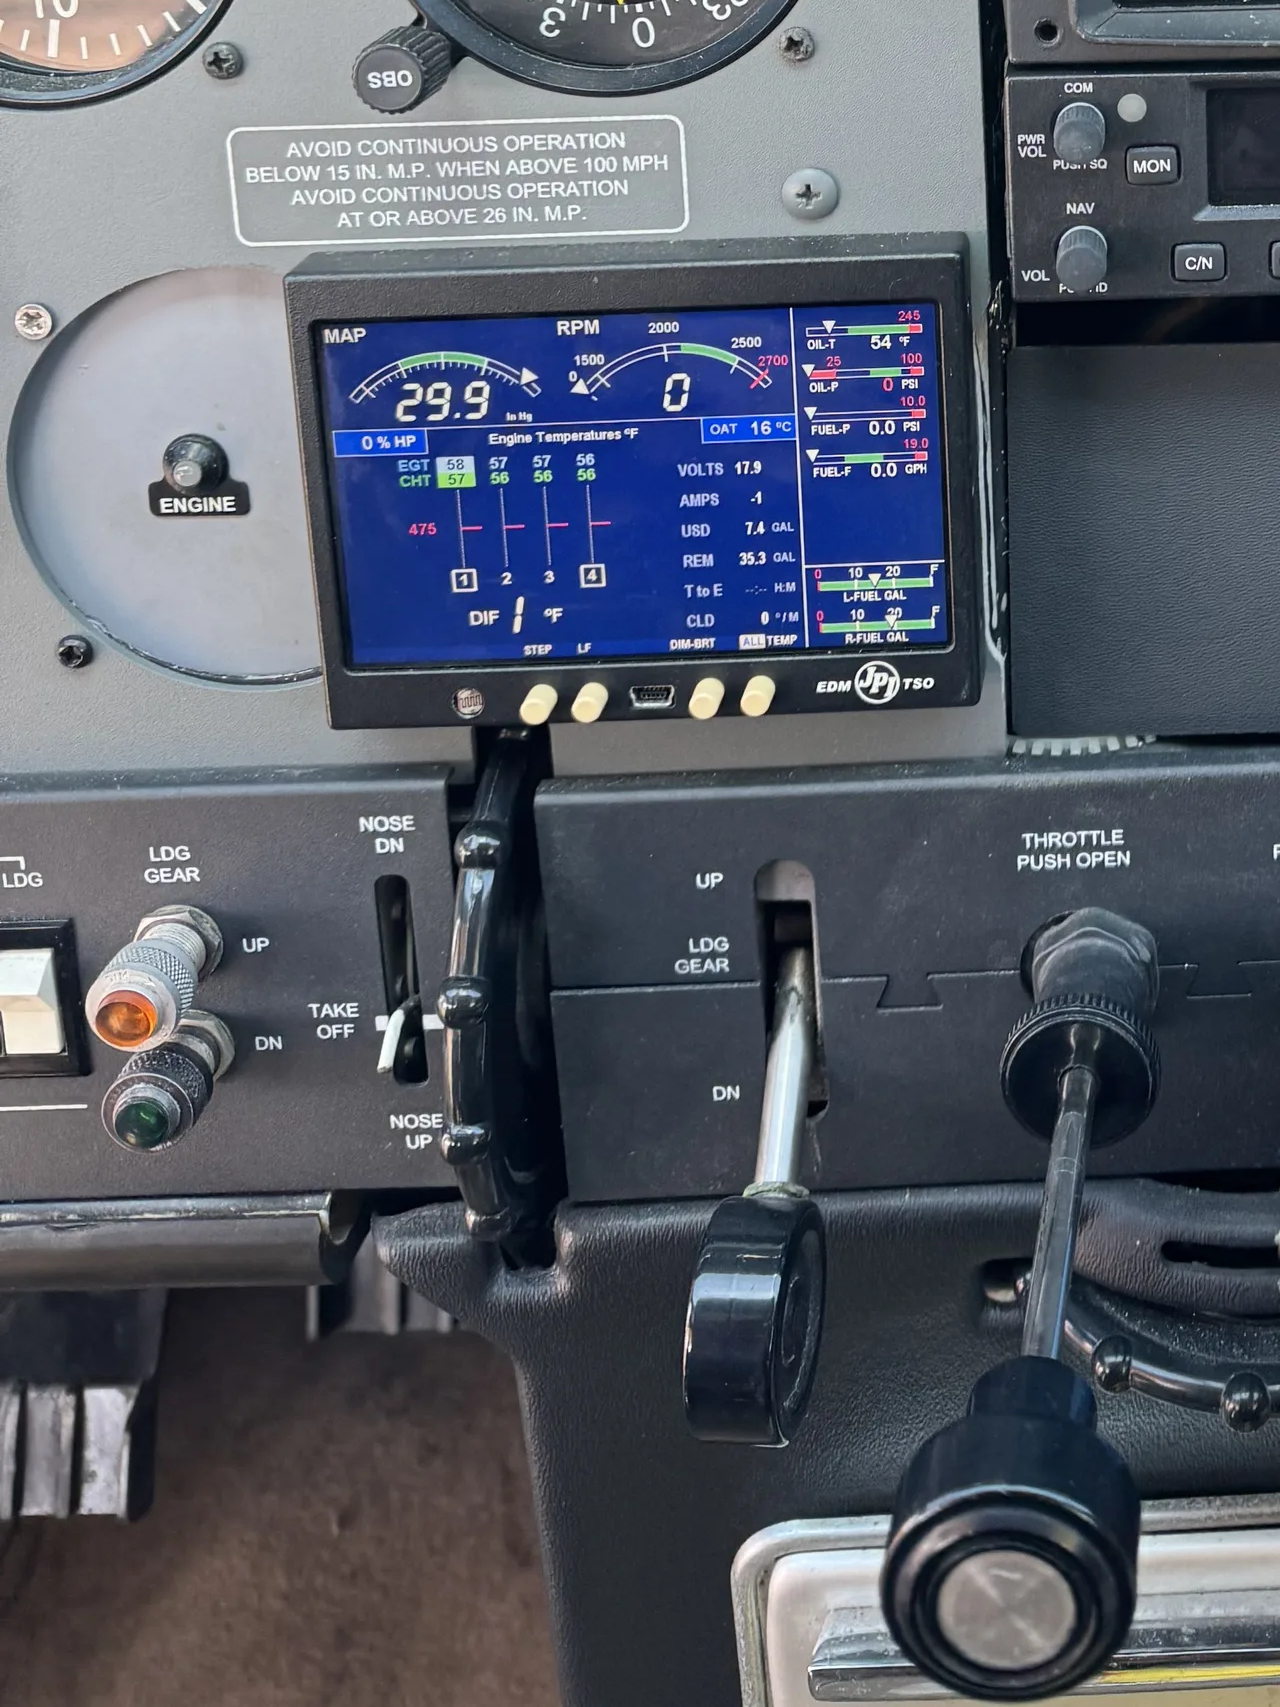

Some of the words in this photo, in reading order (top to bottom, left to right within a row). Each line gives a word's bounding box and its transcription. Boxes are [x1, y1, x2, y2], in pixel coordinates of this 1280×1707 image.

[366, 69, 413, 88] OBS
[1064, 82, 1093, 93] COM
[287, 140, 351, 158] AVOID
[357, 136, 497, 156] CONTINUOUS
[503, 132, 625, 152] OPERATION
[1018, 134, 1045, 145] PWR
[1018, 146, 1046, 158] VOL
[245, 165, 320, 183] BELOW
[326, 164, 349, 181] 15
[356, 163, 382, 180] IN.
[388, 162, 430, 179] M.P.
[437, 160, 500, 178] WHEN
[505, 158, 577, 176] ABOVE
[584, 156, 616, 174] 100
[623, 154, 668, 172] MPH
[1133, 159, 1171, 174] MON
[1066, 202, 1094, 214] NAV
[337, 211, 364, 229] AT
[369, 210, 401, 227] OR
[406, 208, 477, 225] ABOVE
[482, 206, 506, 224] 26
[512, 206, 538, 223] IN.
[544, 204, 587, 222] M.P.
[1185, 255, 1213, 270] C/N
[1021, 270, 1049, 282] VOL
[556, 320, 600, 336] RPM
[648, 322, 679, 333] 2000
[323, 328, 366, 344] MAP
[731, 337, 762, 348] 2500
[807, 339, 836, 350] OIL-T
[574, 354, 605, 366] 1500
[758, 355, 788, 367] 2700
[809, 381, 839, 393] OIL-P
[396, 381, 490, 423] 29.9
[710, 423, 738, 435] OAT
[811, 423, 850, 436] FUEL-P
[395, 434, 416, 448] HP
[488, 432, 533, 447] Engine
[536, 429, 621, 444] Temperatures
[398, 459, 429, 473] EGT
[677, 462, 723, 477] VOLTS
[734, 461, 762, 474] 17.9
[813, 465, 852, 478] FUEL-F
[905, 463, 927, 474] GPH
[399, 474, 431, 487] CHT
[159, 496, 236, 514] ENGINE
[679, 493, 719, 508] AMPS
[681, 524, 711, 537] USD
[745, 522, 765, 536] 7.4
[772, 522, 794, 533] GAL
[683, 554, 714, 567] REM
[739, 552, 766, 565] 35.3
[843, 590, 881, 602] L-FUEL
[468, 610, 500, 625] DIF
[687, 613, 715, 627] CLD
[670, 637, 716, 650] DIM-BRT
[742, 636, 764, 647] ALL
[767, 635, 798, 647] TEMP
[845, 632, 883, 644] R-FUEL
[524, 644, 552, 656] STEP
[816, 680, 851, 693] EDM
[903, 677, 934, 689] TSO
[359, 816, 415, 832] NOSE
[375, 838, 404, 854] DN
[1022, 829, 1125, 849] THROTTLE
[149, 846, 191, 862] LDG
[1017, 852, 1071, 871] PUSH
[1076, 850, 1131, 868] OPEN
[2, 872, 43, 888] LDG
[144, 866, 200, 883] GEAR
[696, 872, 723, 890] UP
[242, 937, 270, 953] UP
[308, 1003, 359, 1019] TAKE
[316, 1024, 354, 1039] OFF
[255, 1035, 282, 1050] DN
[712, 1085, 740, 1102] DN
[389, 1113, 443, 1130] NOSE
[405, 1134, 433, 1150] UP
